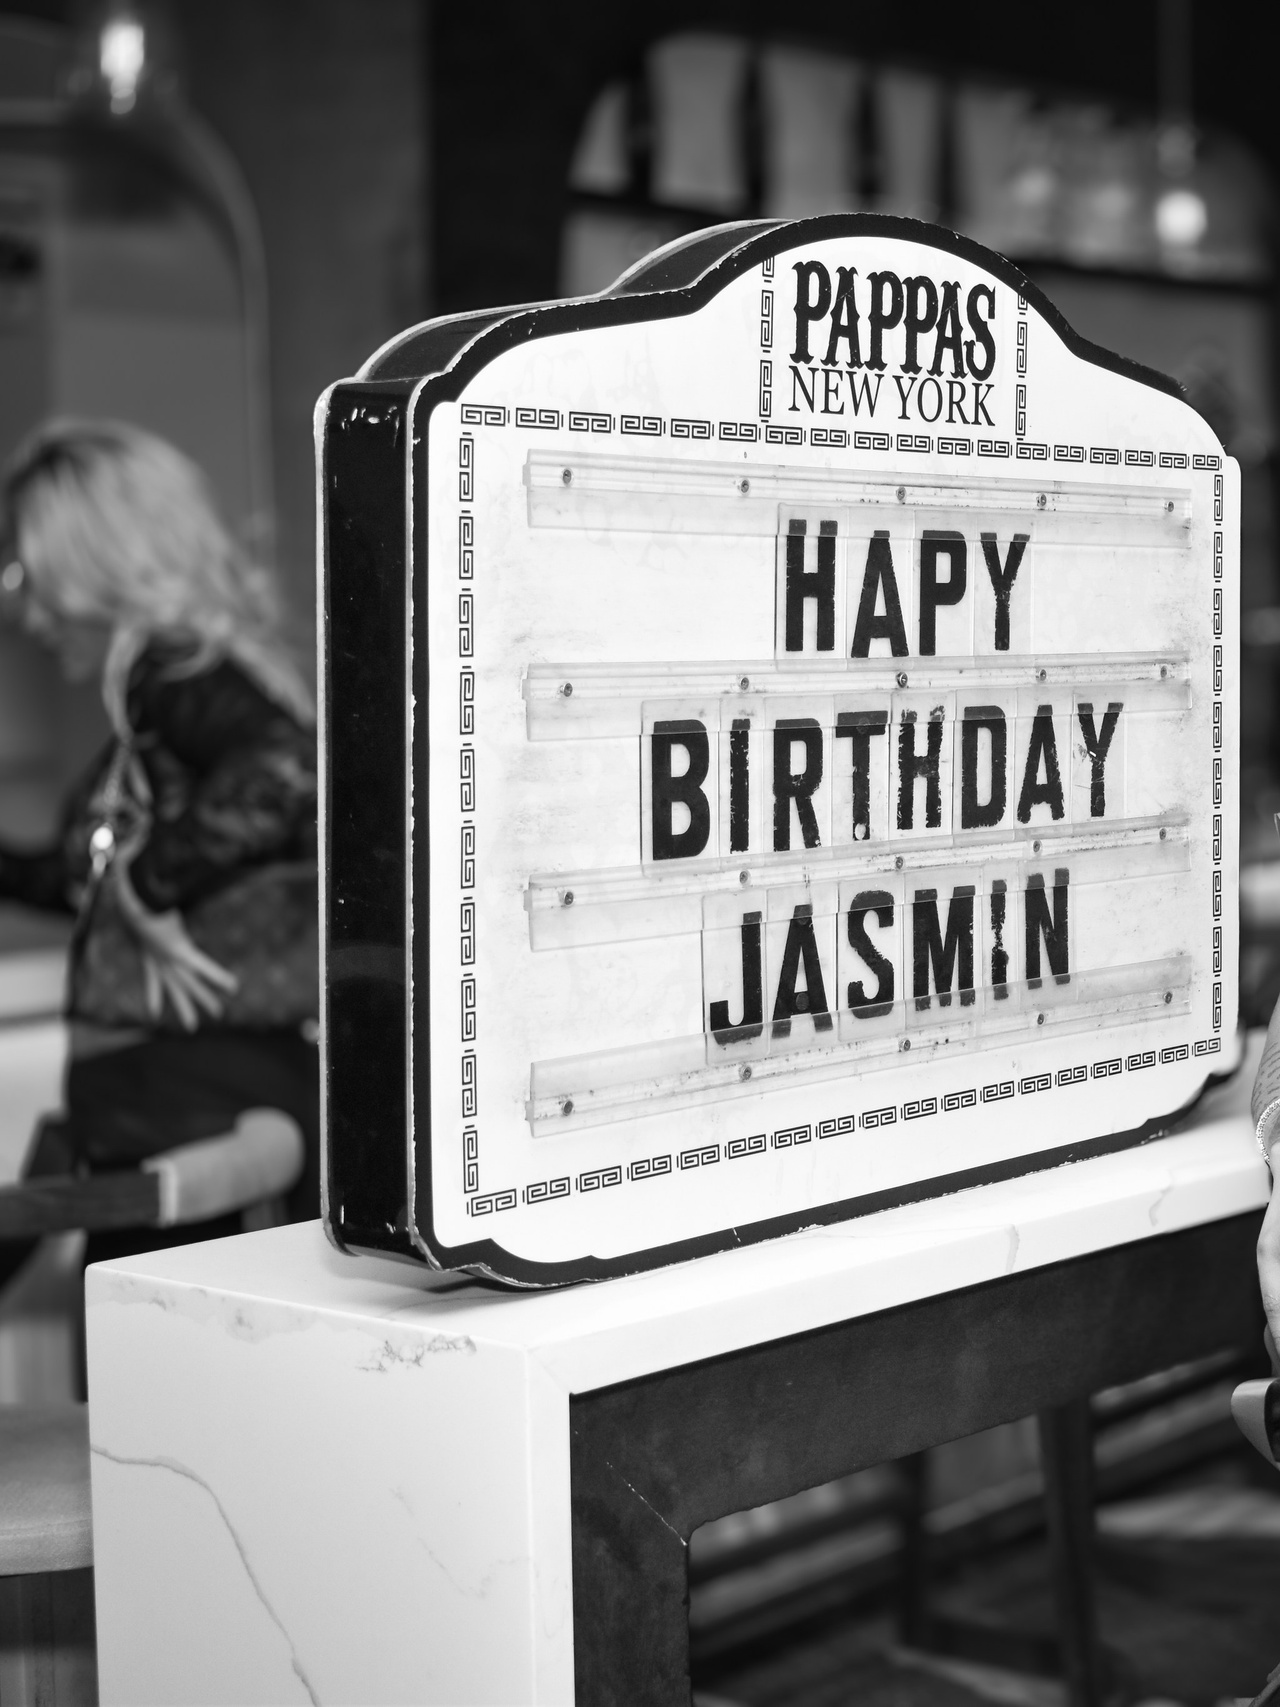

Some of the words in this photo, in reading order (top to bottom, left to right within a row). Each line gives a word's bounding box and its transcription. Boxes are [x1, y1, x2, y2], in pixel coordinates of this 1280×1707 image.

[789, 260, 997, 381] PAPPAS
[788, 366, 884, 418] NEW
[893, 374, 996, 427] YORK
[785, 519, 1031, 658] HAPY
[652, 702, 1124, 860] BIRTHDAY
[709, 867, 1071, 1044] JASMIN
